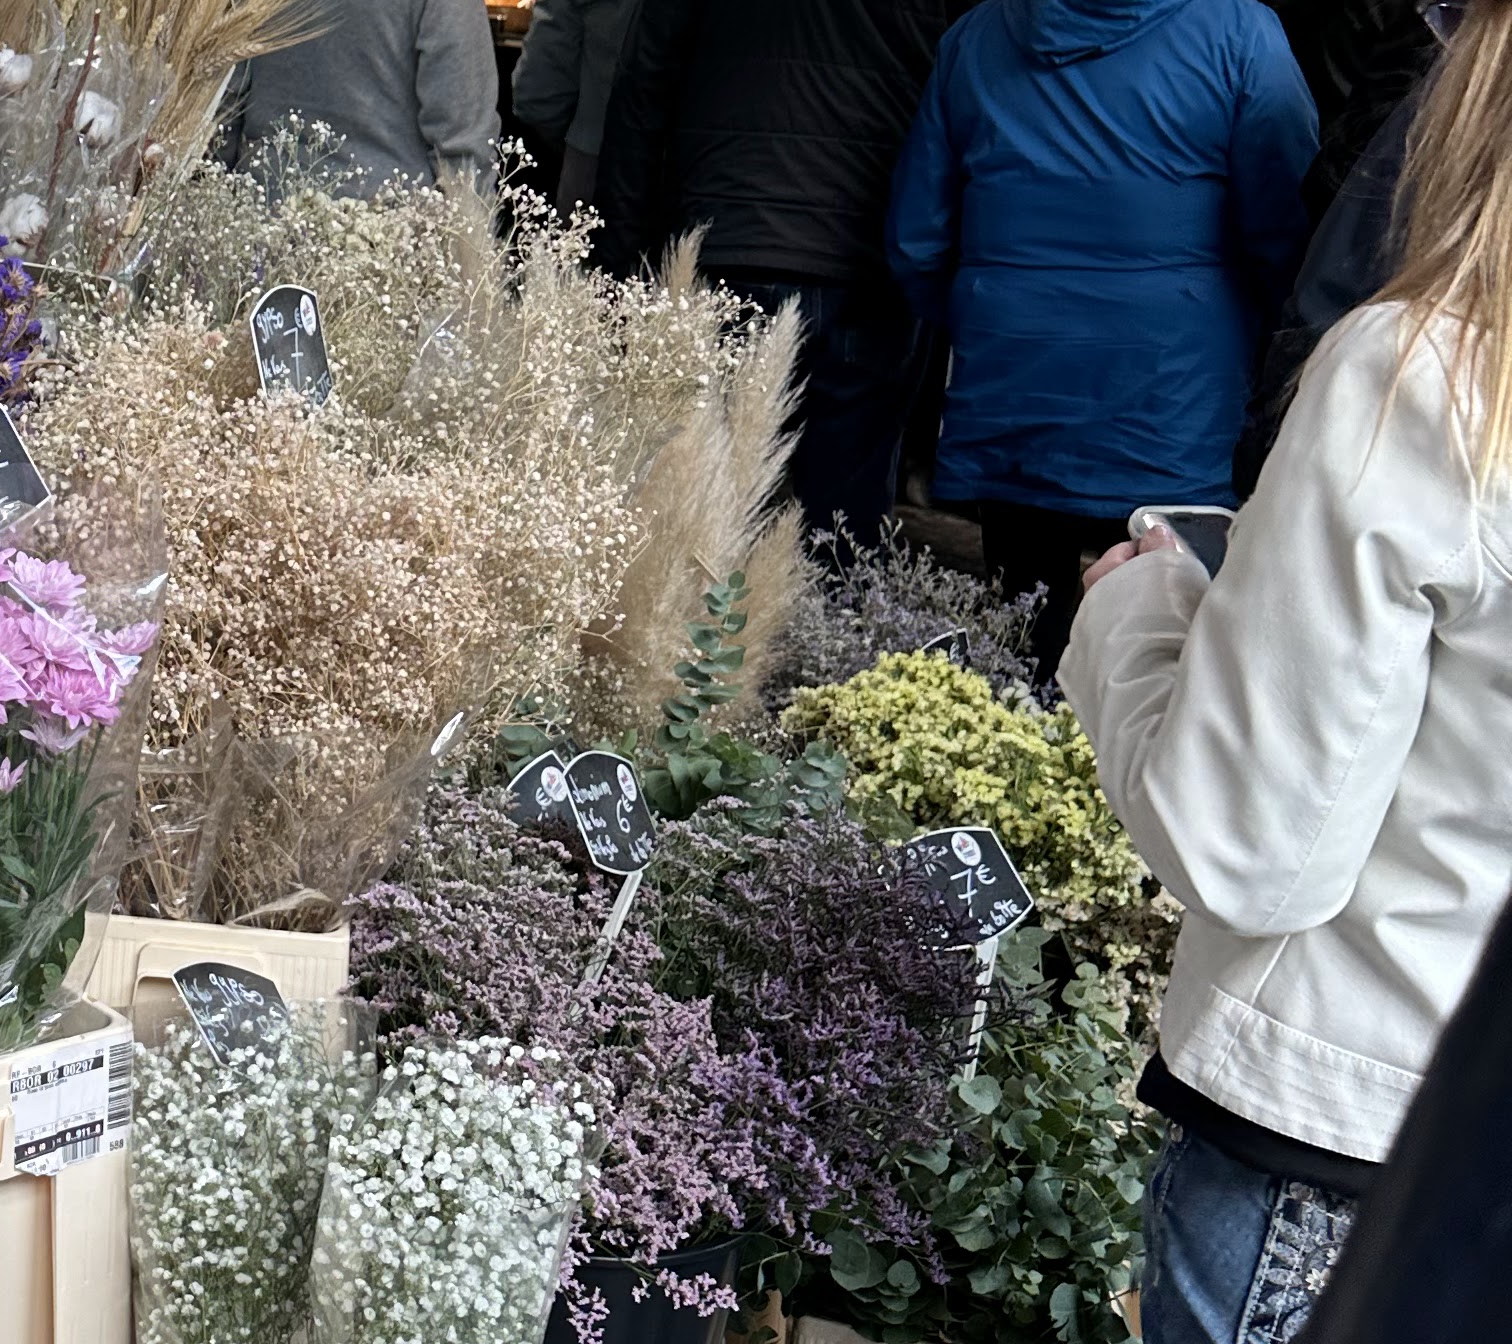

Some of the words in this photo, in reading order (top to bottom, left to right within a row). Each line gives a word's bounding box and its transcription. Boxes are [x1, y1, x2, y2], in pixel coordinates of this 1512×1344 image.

[975, 863, 996, 885] €
[13, 1074, 42, 1093] RBOR
[63, 1058, 95, 1077] 00297
